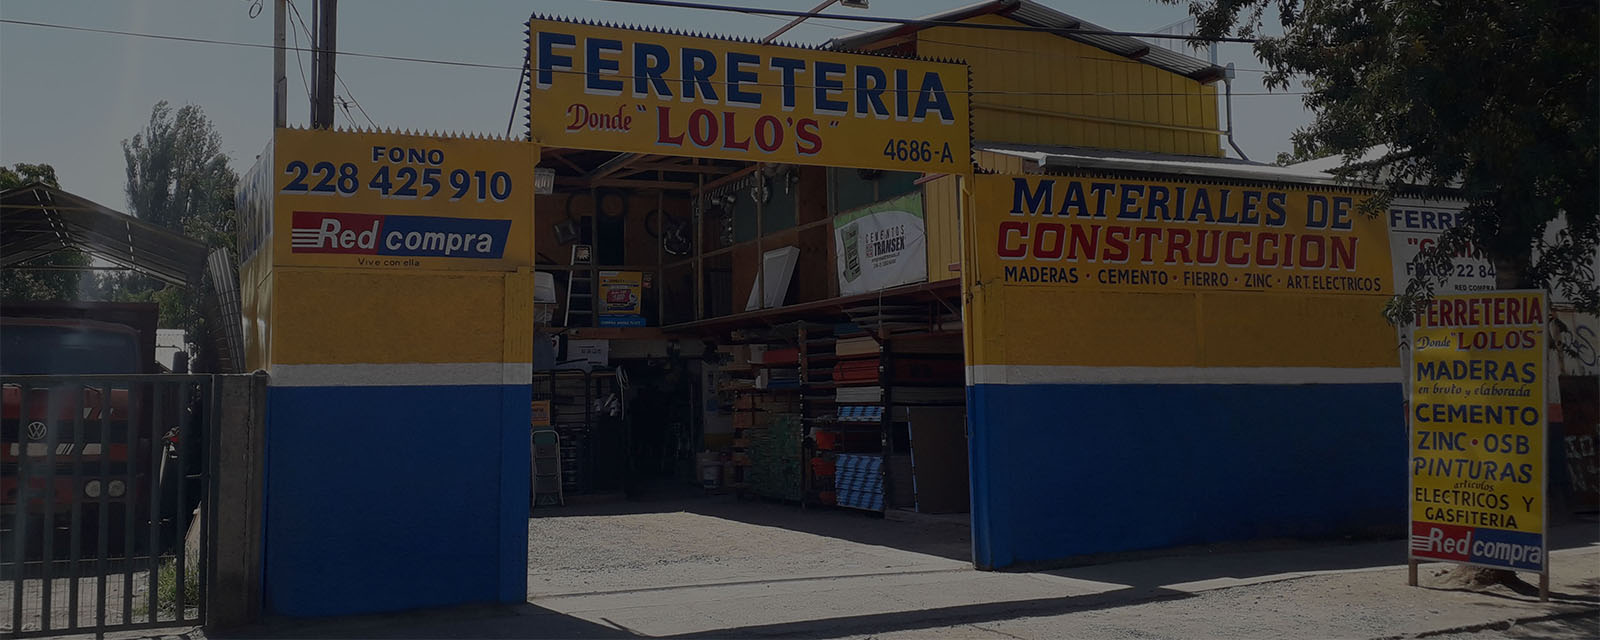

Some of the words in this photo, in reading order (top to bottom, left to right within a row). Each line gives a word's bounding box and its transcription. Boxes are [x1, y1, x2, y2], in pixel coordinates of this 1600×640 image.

[536, 32, 954, 124] FERRETERIA
[565, 103, 632, 133] Donde
[372, 146, 445, 166] FONO
[884, 139, 953, 163] 4686-A
[280, 160, 360, 196] 228
[368, 166, 442, 199] 425
[449, 169, 513, 201] 910
[1010, 178, 1287, 228] MATERIALES
[1304, 194, 1353, 231] DE
[316, 217, 380, 250] Red
[385, 230, 493, 255] compra
[865, 224, 904, 243] CEMENTOS
[874, 236, 905, 256] TRANSEX
[997, 221, 1360, 272] CONSTRUCCION
[358, 257, 381, 266] Vive
[384, 258, 401, 266] con
[403, 258, 420, 267] ella
[1457, 264, 1474, 277] 22
[1004, 266, 1079, 284] MADERAS
[1098, 269, 1168, 285] CEMENTO
[1183, 271, 1229, 287] FIERRO
[1245, 273, 1273, 288] ZINC
[1415, 297, 1543, 327] FERRETERIA
[1416, 336, 1450, 350] Donde
[1416, 360, 1536, 384] MADERAS
[1418, 386, 1429, 394] en
[1433, 384, 1462, 395] bruto
[1465, 389, 1471, 398] y
[1474, 382, 1531, 397] elaborada
[1415, 403, 1539, 426] CEMENTO
[1417, 431, 1467, 451] ZINC
[1484, 433, 1530, 455] OSB
[1413, 457, 1533, 484] PINTURAS
[1454, 479, 1495, 492] articulos
[1415, 487, 1510, 510] ELECTRICOS
[1522, 496, 1534, 513] Y
[1425, 507, 1518, 529] GASFITERIA
[1428, 527, 1472, 555] Red
[1472, 539, 1543, 566] compra
